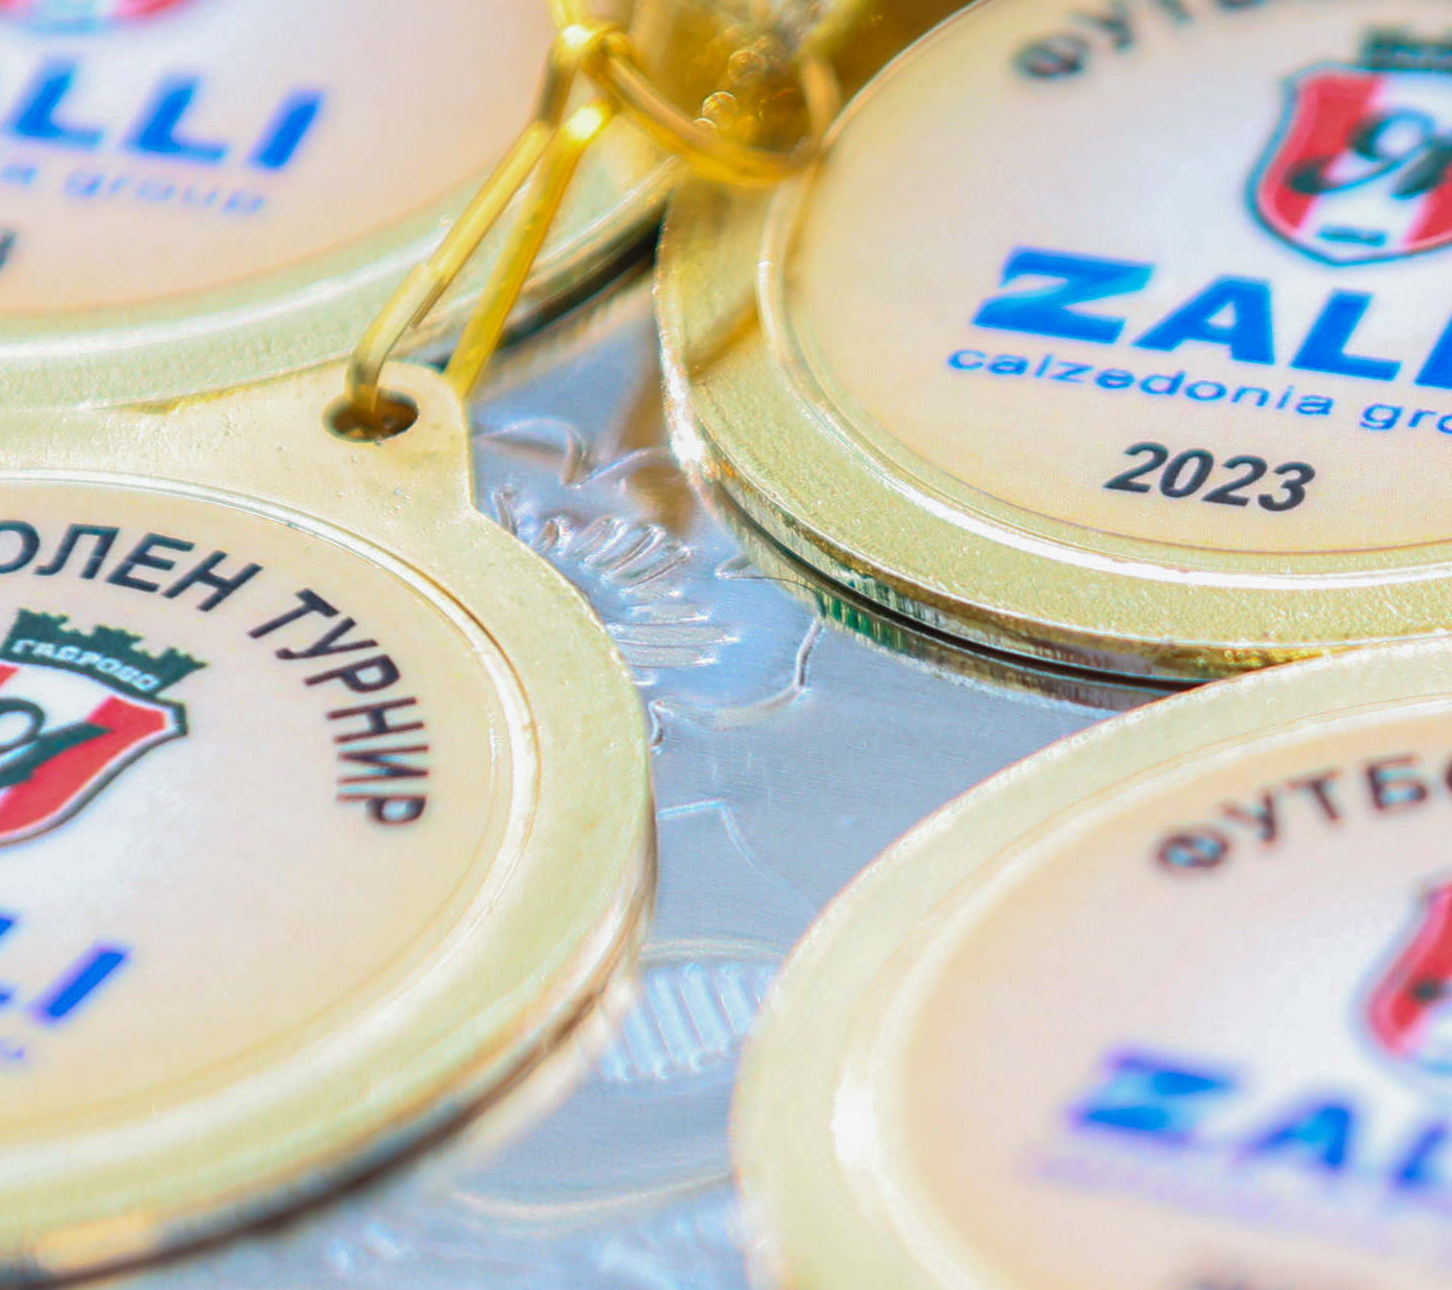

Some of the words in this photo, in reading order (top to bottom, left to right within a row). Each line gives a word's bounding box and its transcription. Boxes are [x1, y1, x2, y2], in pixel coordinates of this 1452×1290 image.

[948, 345, 1333, 417] calzedonia
[1103, 441, 1316, 512] 2023
[247, 587, 431, 829] ТУРНИР
